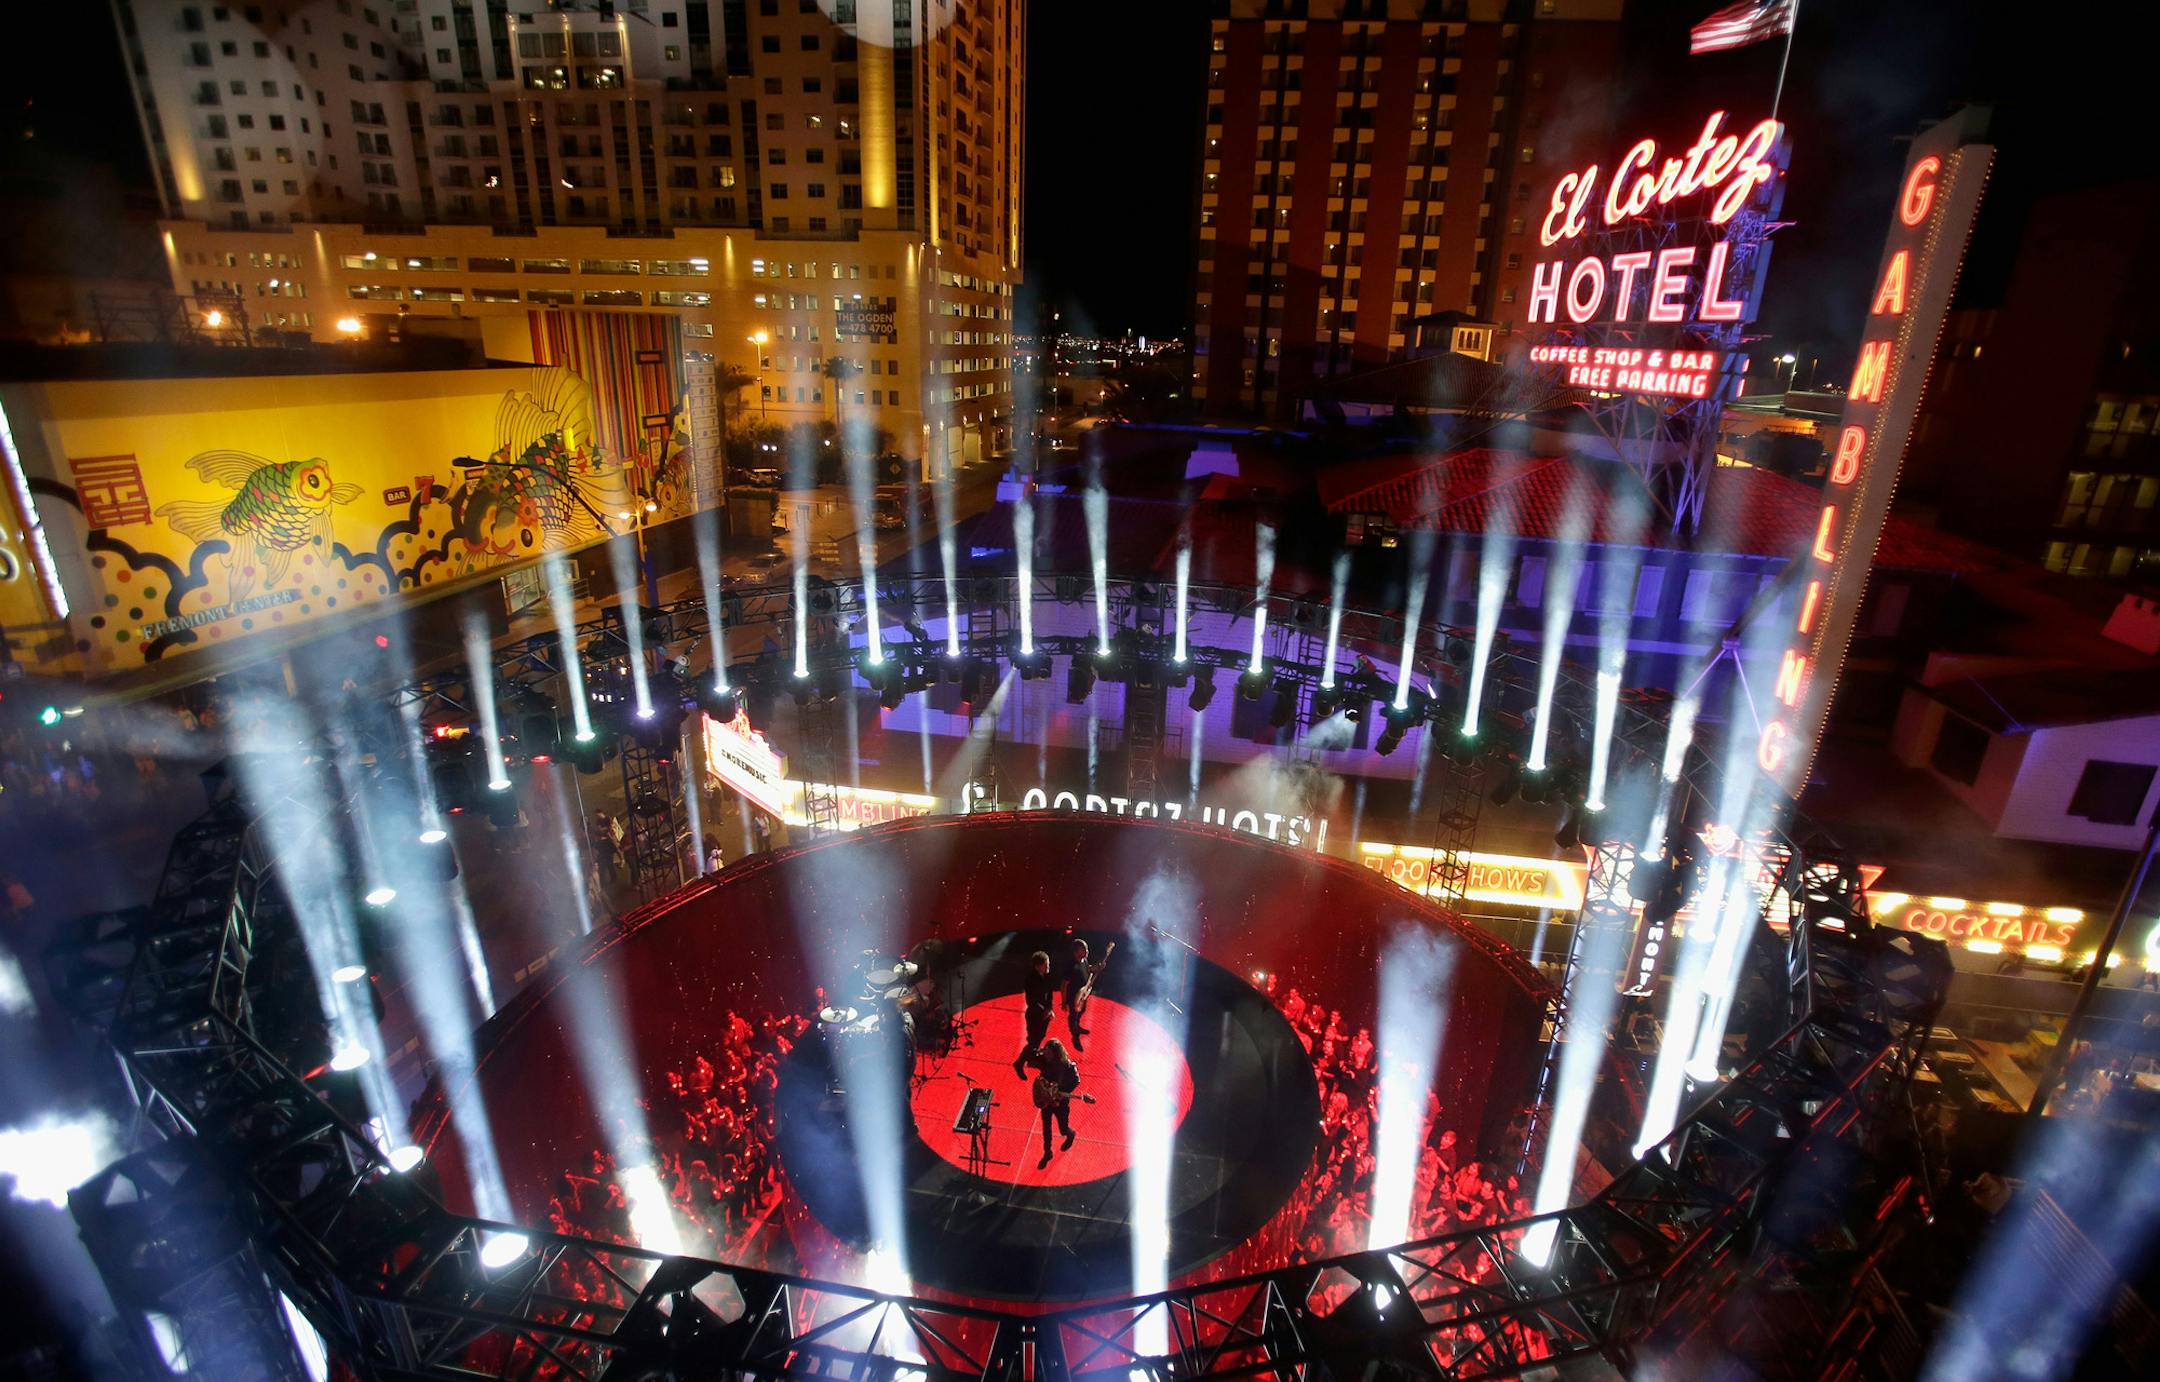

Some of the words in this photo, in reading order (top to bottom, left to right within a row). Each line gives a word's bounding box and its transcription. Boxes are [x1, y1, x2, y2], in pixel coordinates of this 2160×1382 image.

[1540, 164, 1598, 247] El
[1603, 110, 1778, 225] Cortez
[1528, 241, 1744, 323] HOTEL
[838, 312, 854, 322] THE
[857, 313, 894, 323] OGDEN
[1530, 346, 1588, 363] COFFEE
[1594, 349, 1643, 366] SHOP
[1647, 351, 1663, 368] &
[1669, 352, 1715, 370] BAR
[1569, 367, 1612, 387] FREE
[1616, 369, 1709, 396] PARKING
[1758, 155, 1942, 773] GAMBLING
[141, 606, 227, 640] FREMONT
[1905, 908, 2077, 947] COCKTAILS
